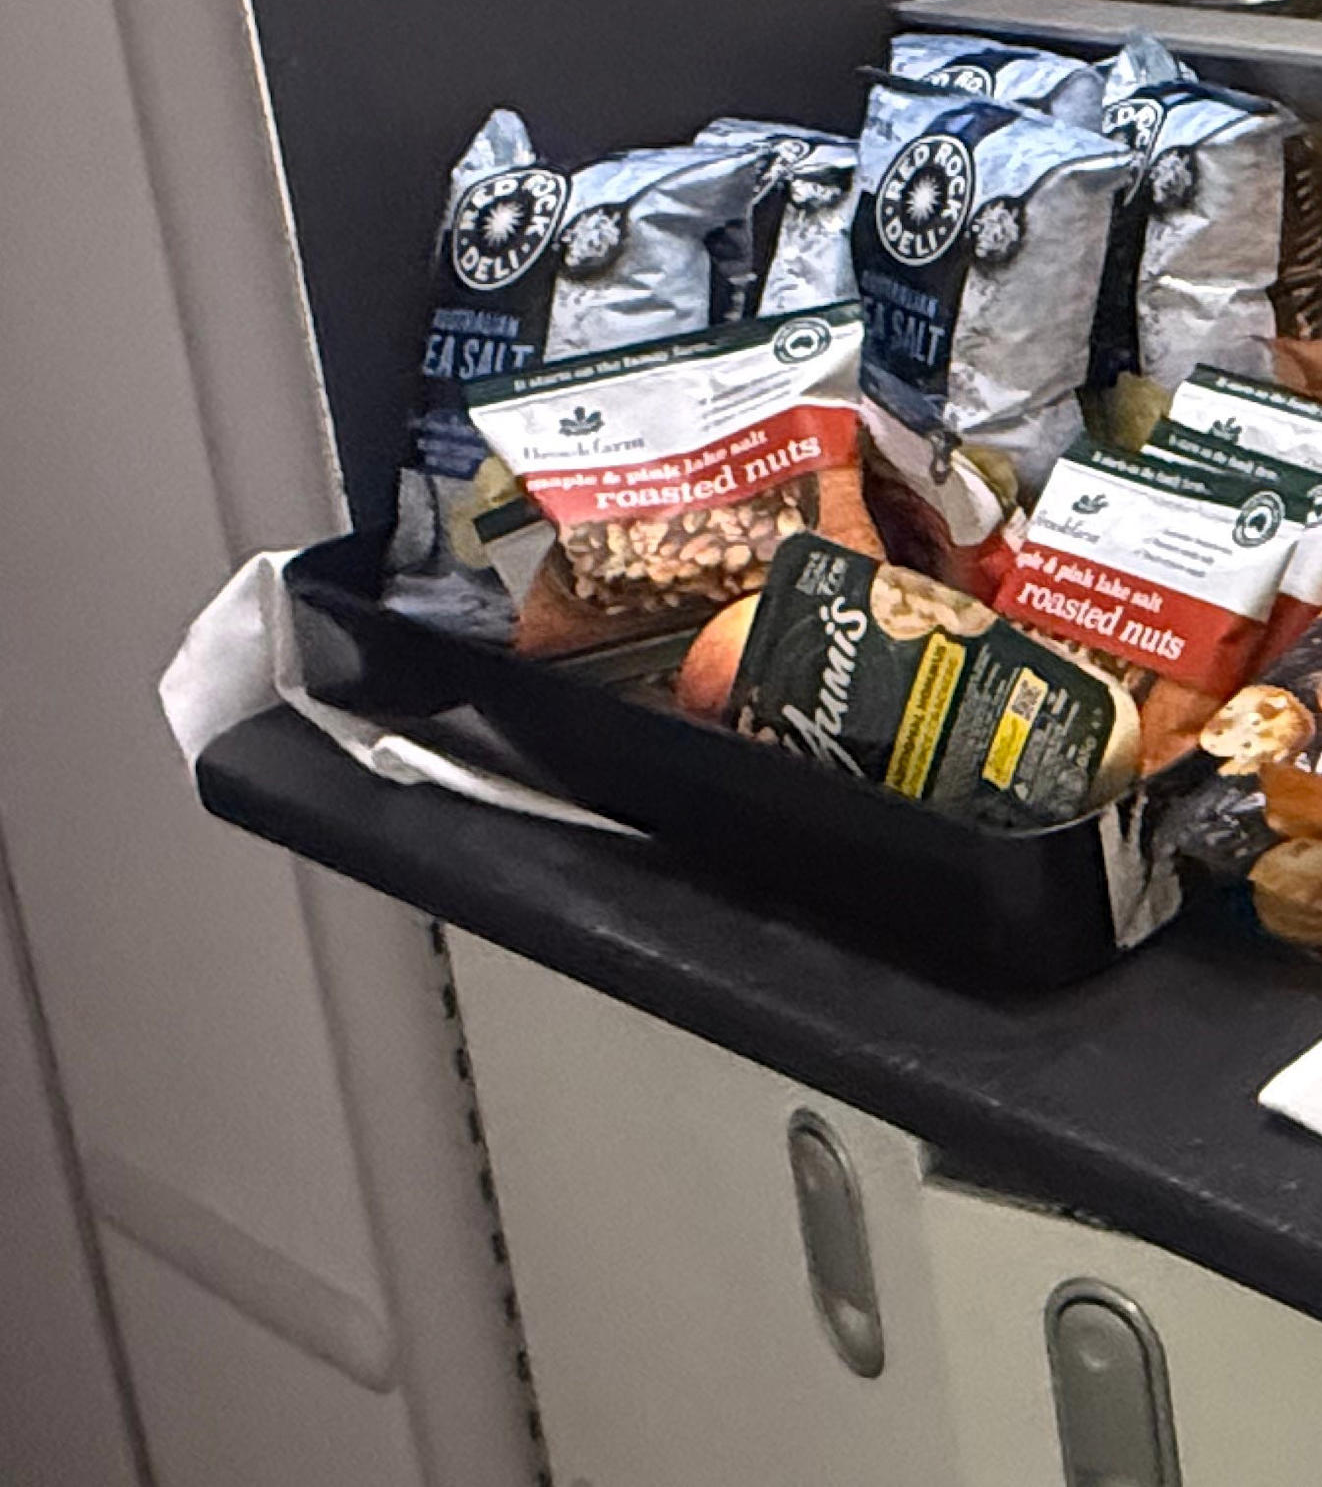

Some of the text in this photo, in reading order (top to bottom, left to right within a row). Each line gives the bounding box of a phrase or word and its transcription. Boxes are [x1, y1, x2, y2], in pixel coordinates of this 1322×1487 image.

[460, 174, 557, 237] RED ROCK
[885, 142, 930, 201] RED
[934, 142, 966, 221] ROCK
[460, 245, 520, 281] DELI
[885, 216, 939, 257] DELI
[595, 435, 822, 511] roasted nuts
[1016, 581, 1187, 662] roasted nuts
